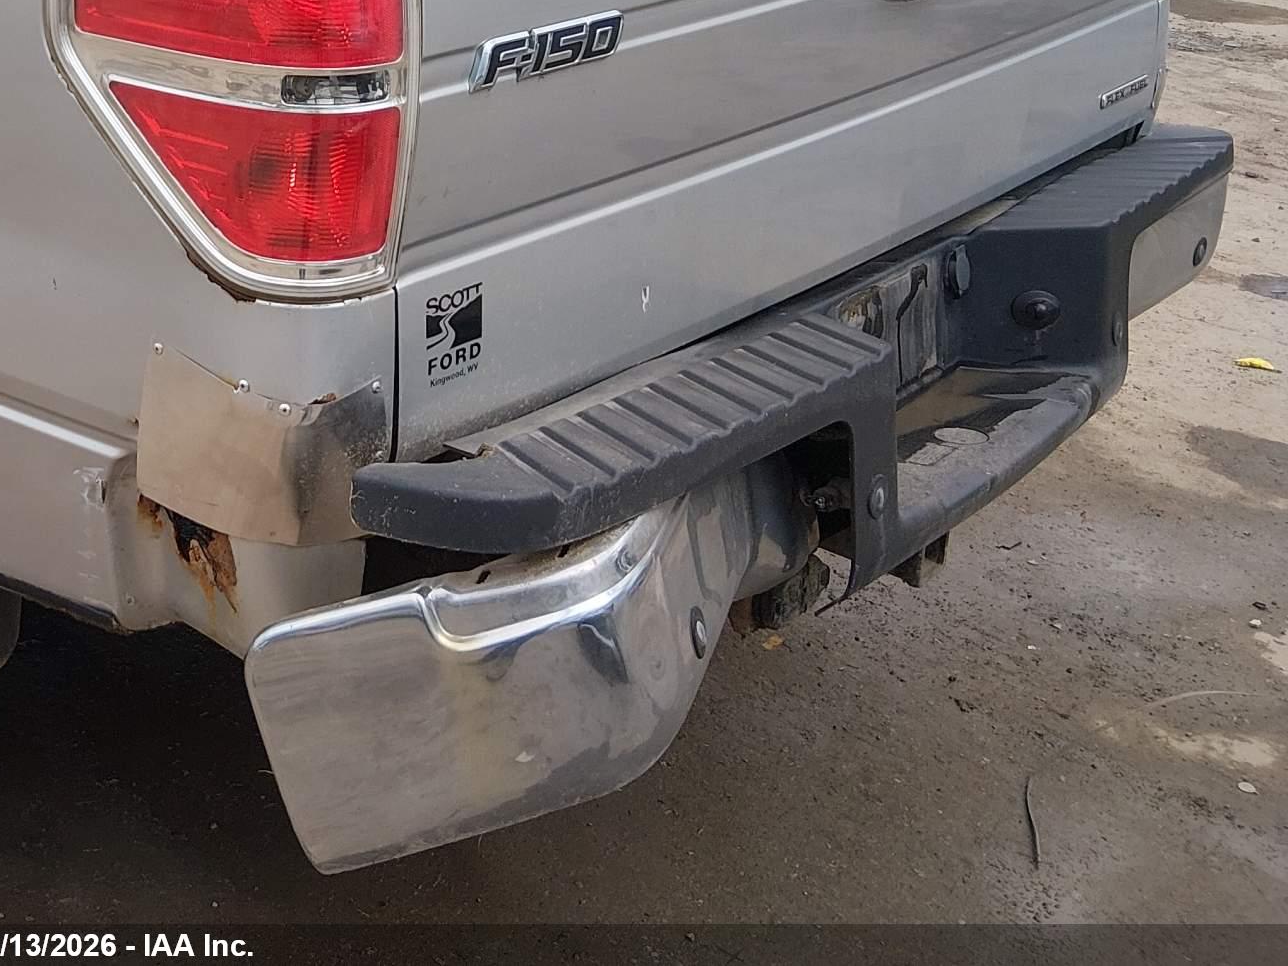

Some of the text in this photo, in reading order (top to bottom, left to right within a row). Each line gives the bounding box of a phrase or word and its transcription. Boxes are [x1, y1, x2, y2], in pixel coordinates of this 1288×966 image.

[468, 9, 624, 94] F-150
[425, 281, 483, 314] SCOTT
[427, 342, 481, 376] FORD
